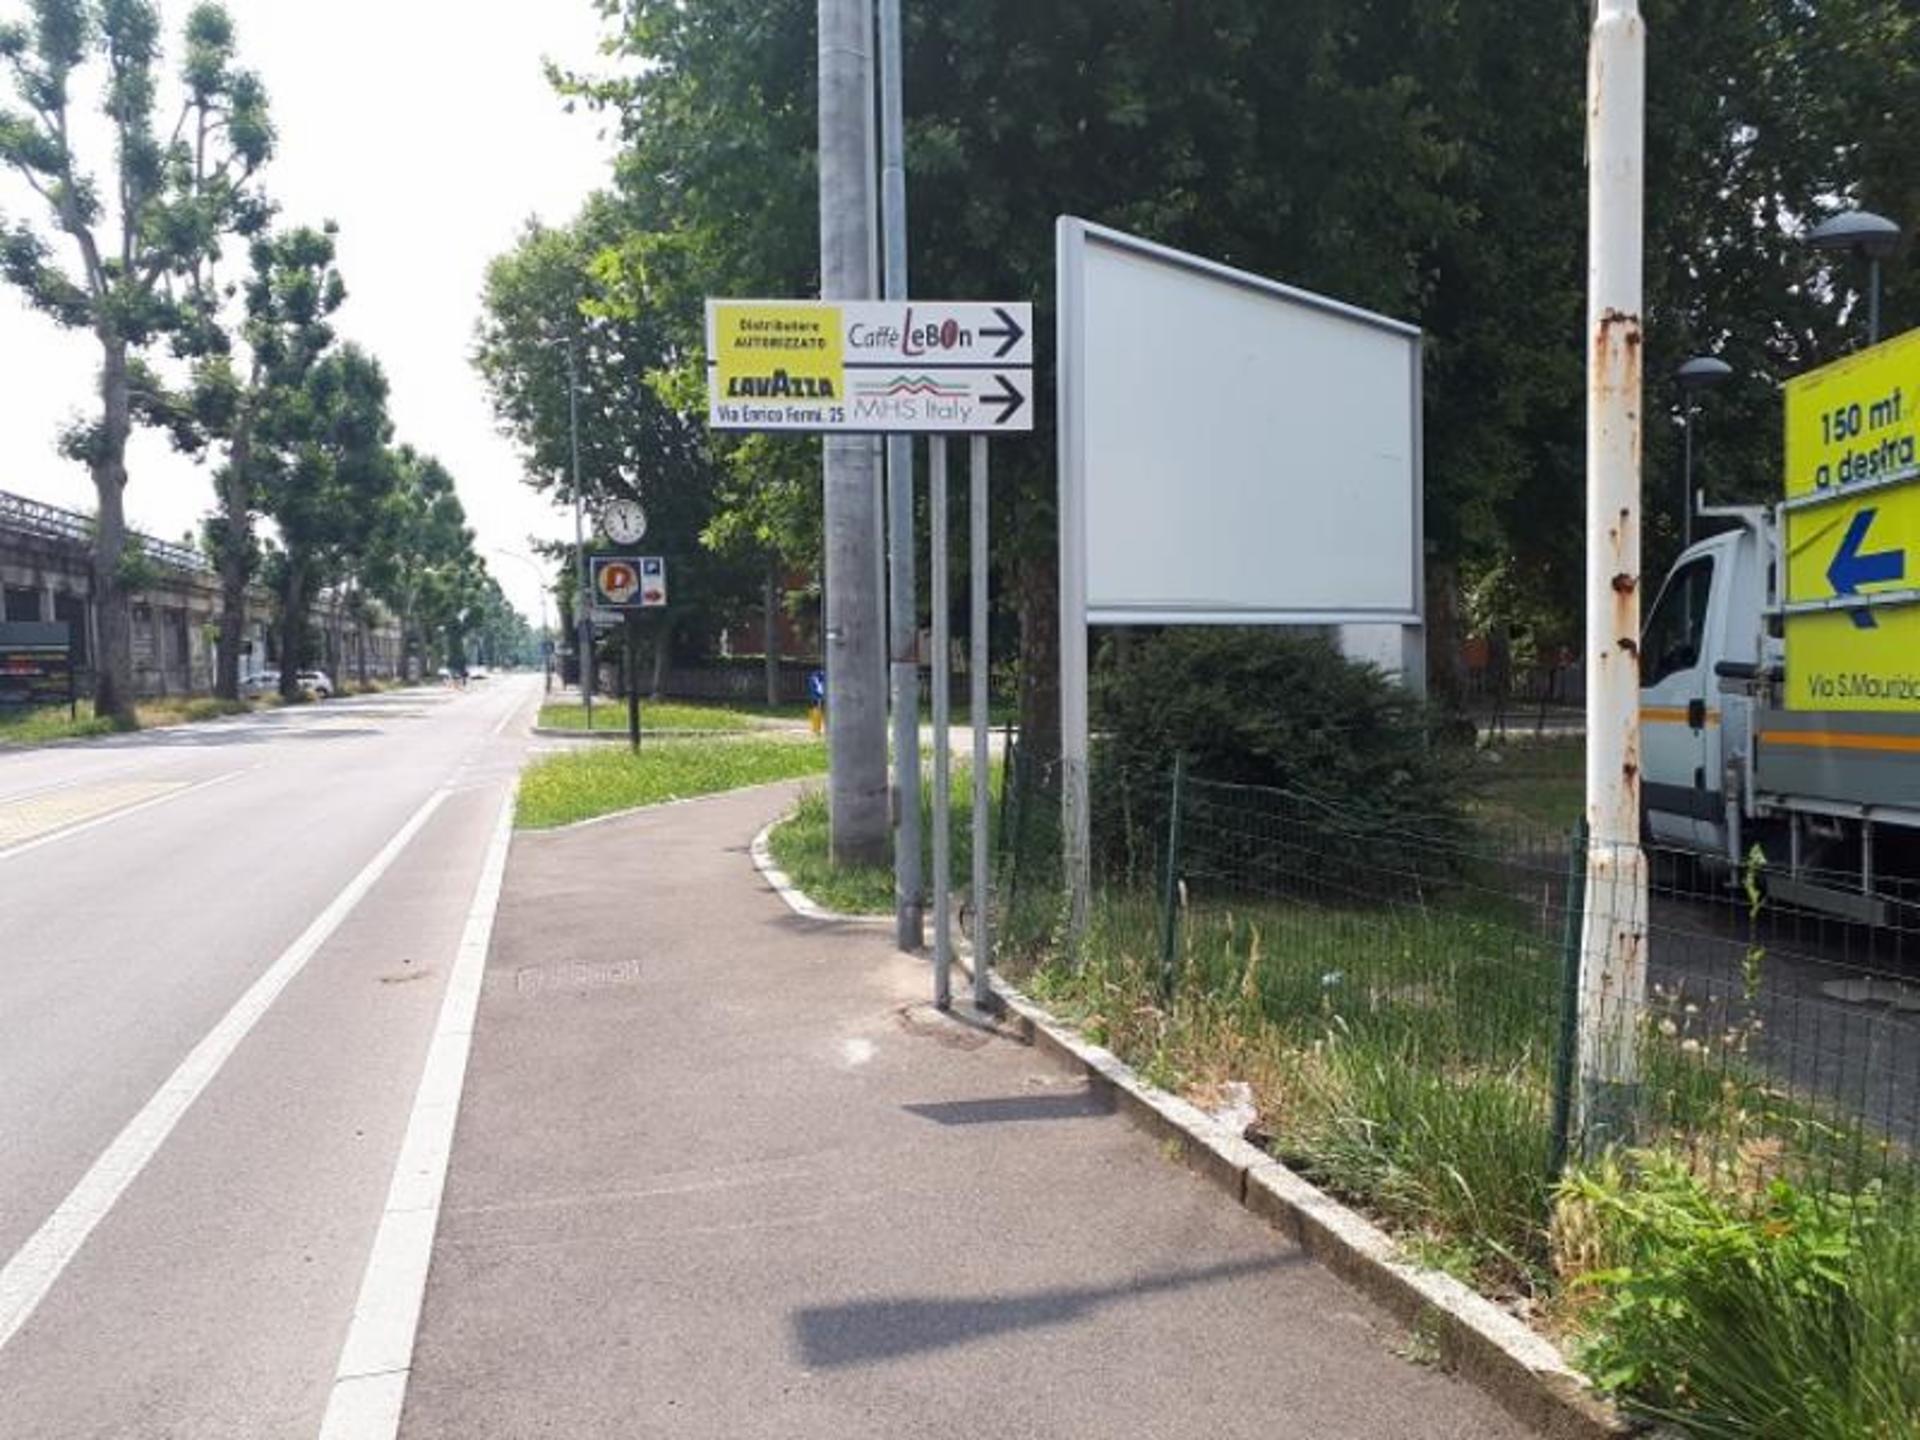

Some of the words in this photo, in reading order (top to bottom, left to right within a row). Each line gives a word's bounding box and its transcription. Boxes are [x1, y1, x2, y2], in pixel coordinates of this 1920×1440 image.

[738, 319, 820, 332] Distributore
[733, 336, 827, 351] AUTORIZZATO
[727, 368, 835, 398] LAVAZZA
[717, 404, 738, 422] Via
[743, 404, 783, 422] Enrico
[854, 399, 918, 419] MHS
[925, 399, 972, 423] Italy
[1822, 403, 1861, 446] 150
[1816, 464, 1829, 488] a
[1838, 436, 1914, 485] destra
[1807, 673, 1834, 699] Via
